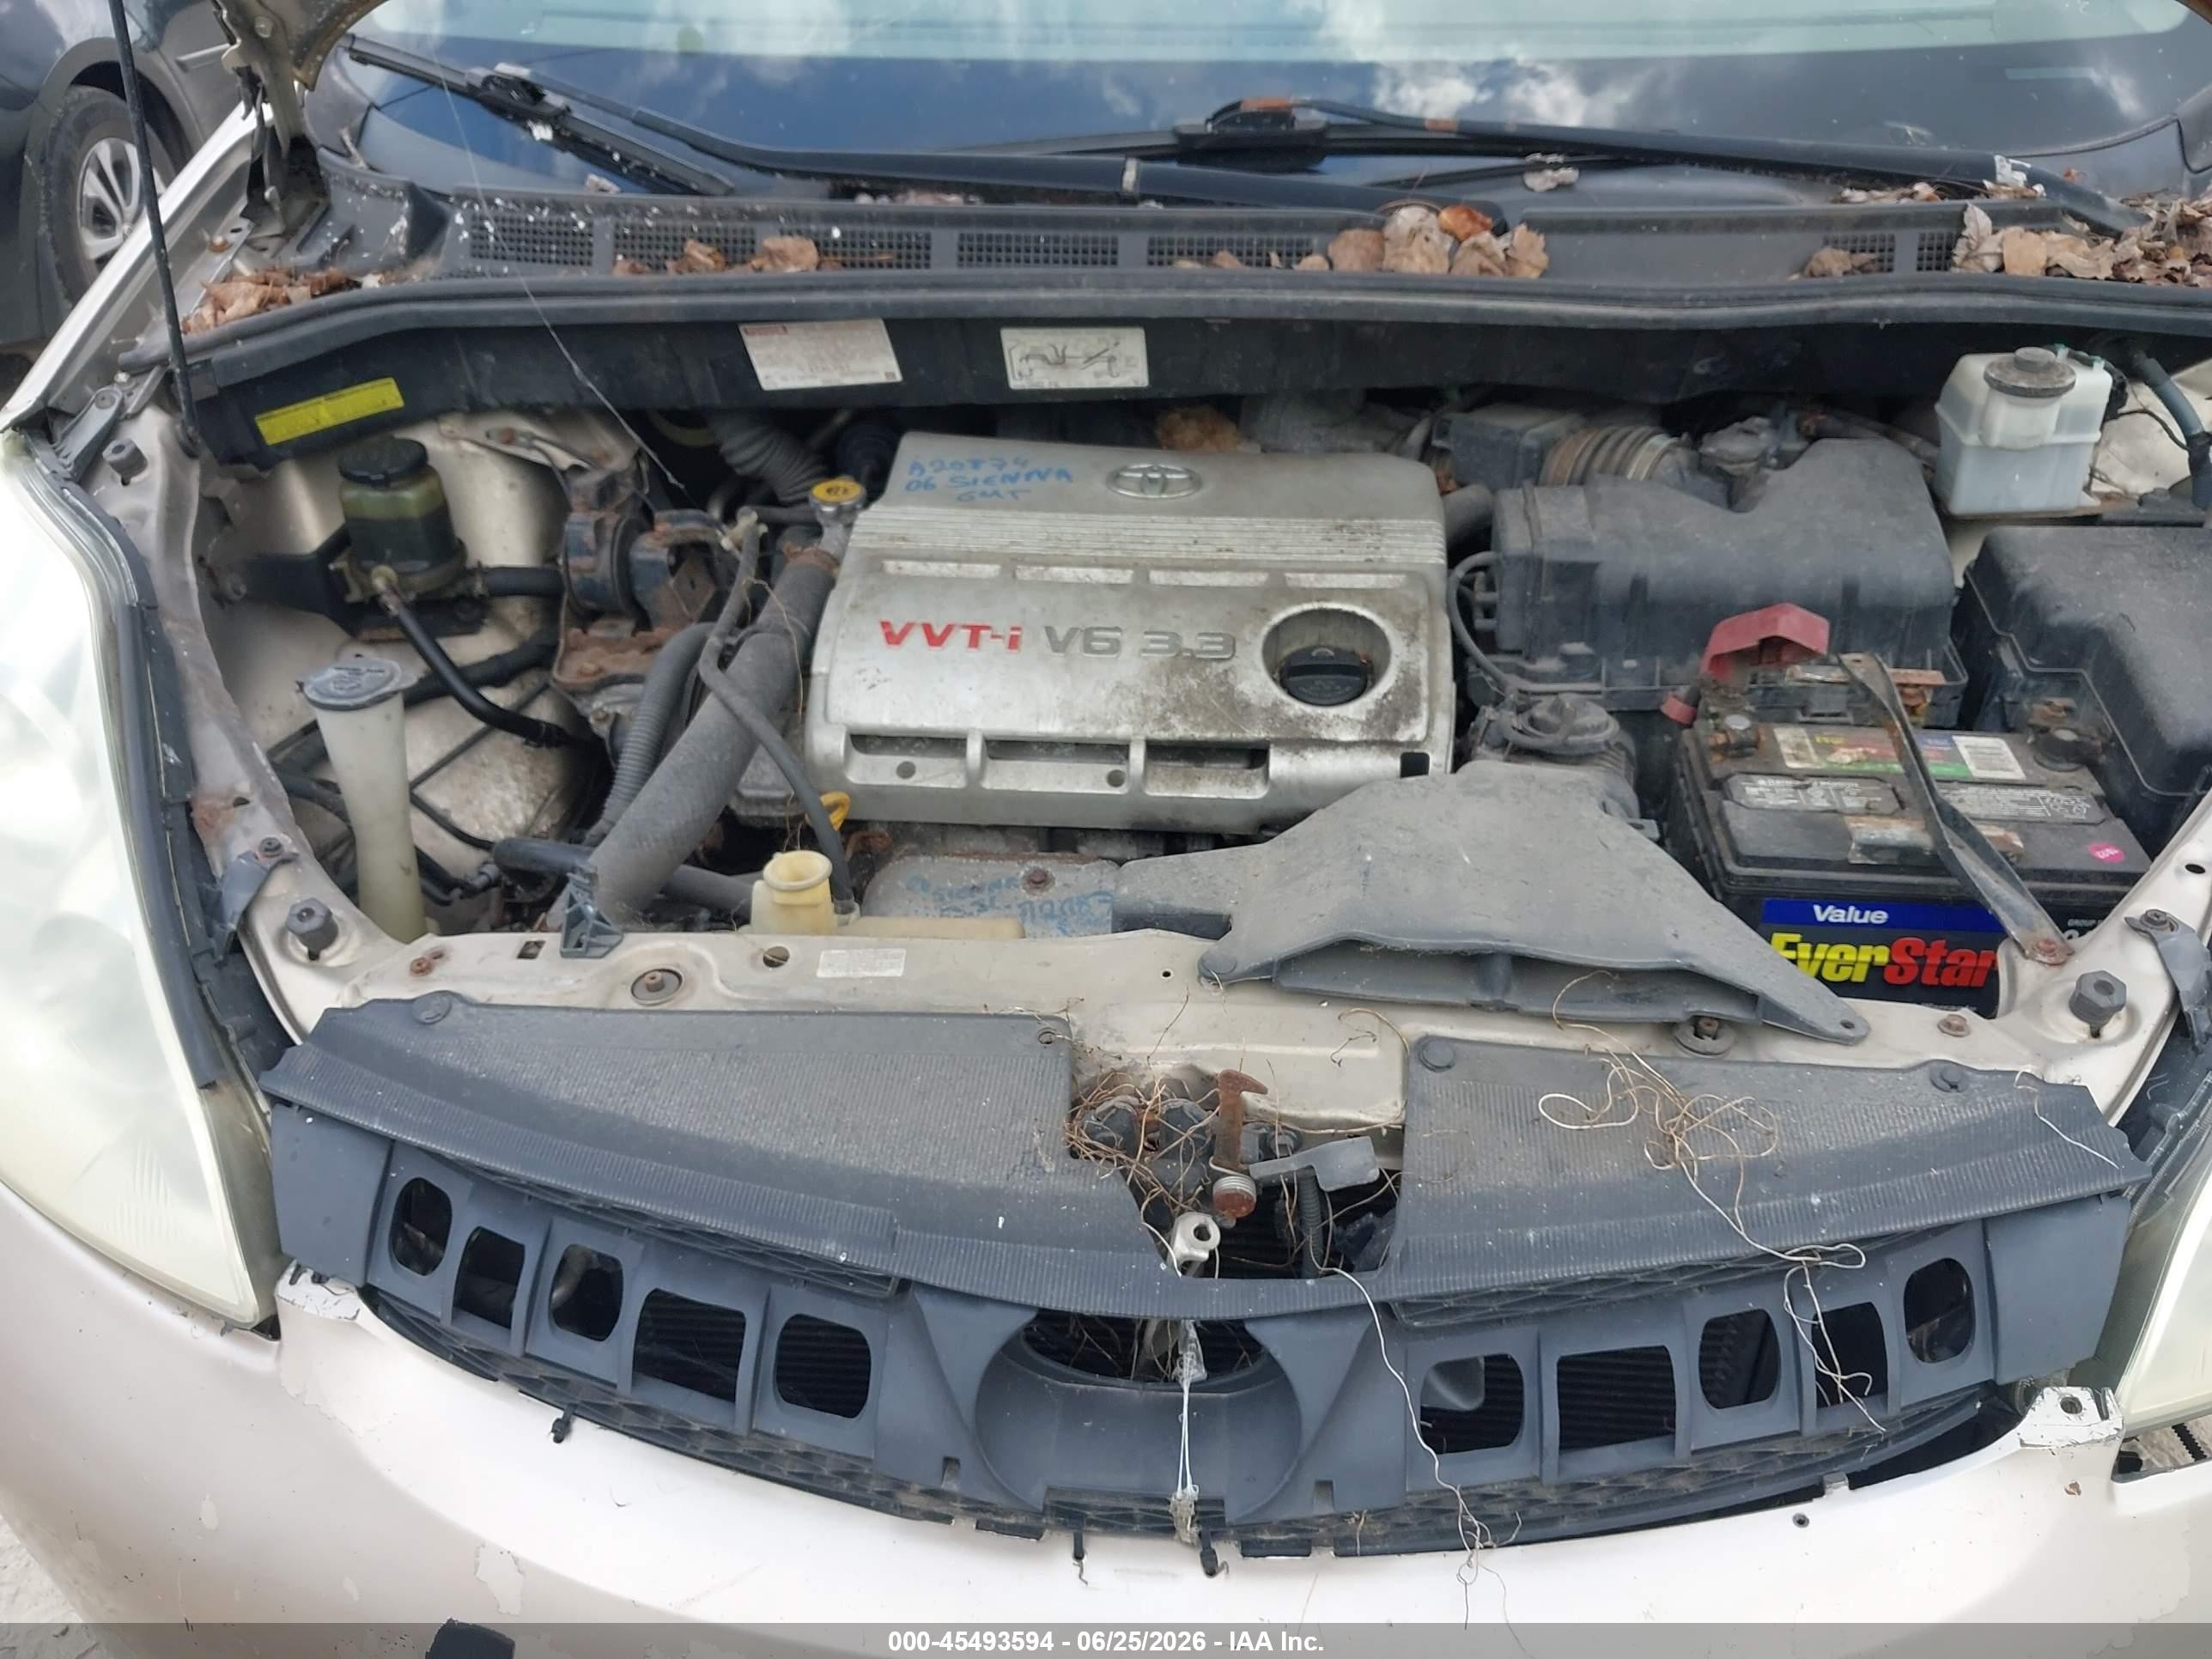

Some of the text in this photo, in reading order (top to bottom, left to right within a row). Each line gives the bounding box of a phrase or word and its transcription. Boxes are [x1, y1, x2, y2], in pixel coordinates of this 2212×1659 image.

[905, 466, 1073, 492] 06 SIENNA
[879, 619, 1237, 660] VVT-i V6 3.3
[1813, 904, 1889, 925] Value
